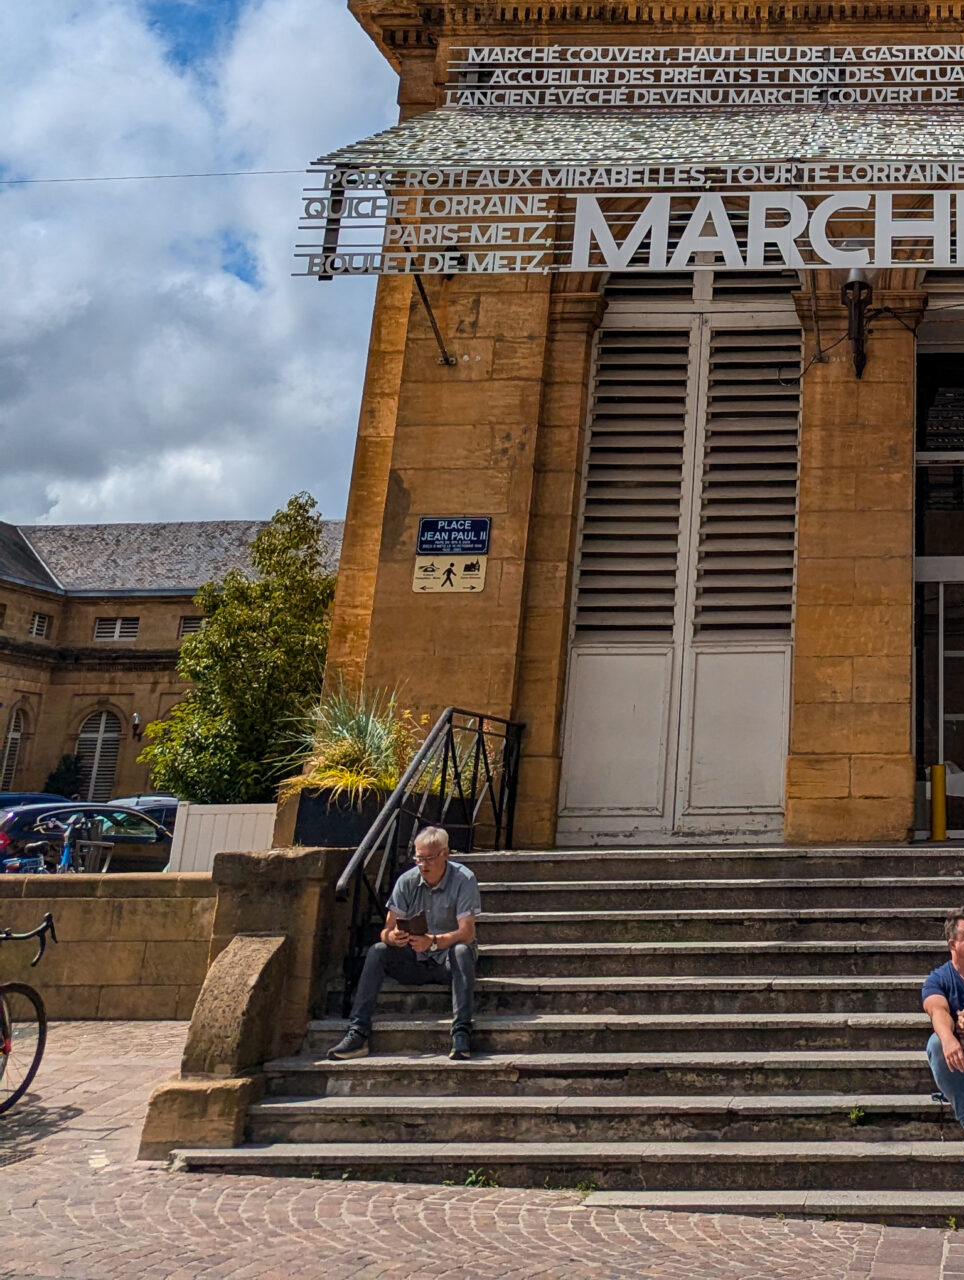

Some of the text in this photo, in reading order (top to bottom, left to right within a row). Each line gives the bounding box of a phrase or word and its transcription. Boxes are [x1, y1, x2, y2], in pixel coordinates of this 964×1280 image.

[468, 45, 561, 62] MARCHÉ
[567, 46, 671, 64] COUVERT,
[678, 46, 740, 62] HAUT
[745, 46, 790, 62] LIEU
[797, 46, 823, 62] DE
[830, 45, 856, 62] LA
[489, 68, 609, 85] ACCUEILLIR
[614, 68, 654, 84] DES
[660, 65, 751, 84] PRÉLATS
[757, 67, 784, 83] ET
[790, 67, 839, 83] NON
[845, 66, 885, 82] DES
[445, 90, 539, 106] L'ANCIEN
[545, 87, 628, 105] ÉVÊCHÉ
[634, 89, 721, 104] DEVENU
[728, 86, 820, 104] MARCHÉ
[827, 87, 927, 103] COUVERT
[932, 87, 959, 103] DE
[324, 170, 395, 189] PORC
[405, 166, 467, 189] RÔTI
[475, 169, 532, 188] AUX
[541, 166, 712, 188] MIRABELLES,
[721, 164, 830, 184] TOURTE
[304, 195, 555, 218] QUICHE LORRAINE,
[387, 223, 552, 247] PARIS-METZ,
[307, 252, 549, 276] BOULET DE METZ,
[438, 520, 472, 530] PLACE
[421, 531, 486, 541] JEAN PAUL II
